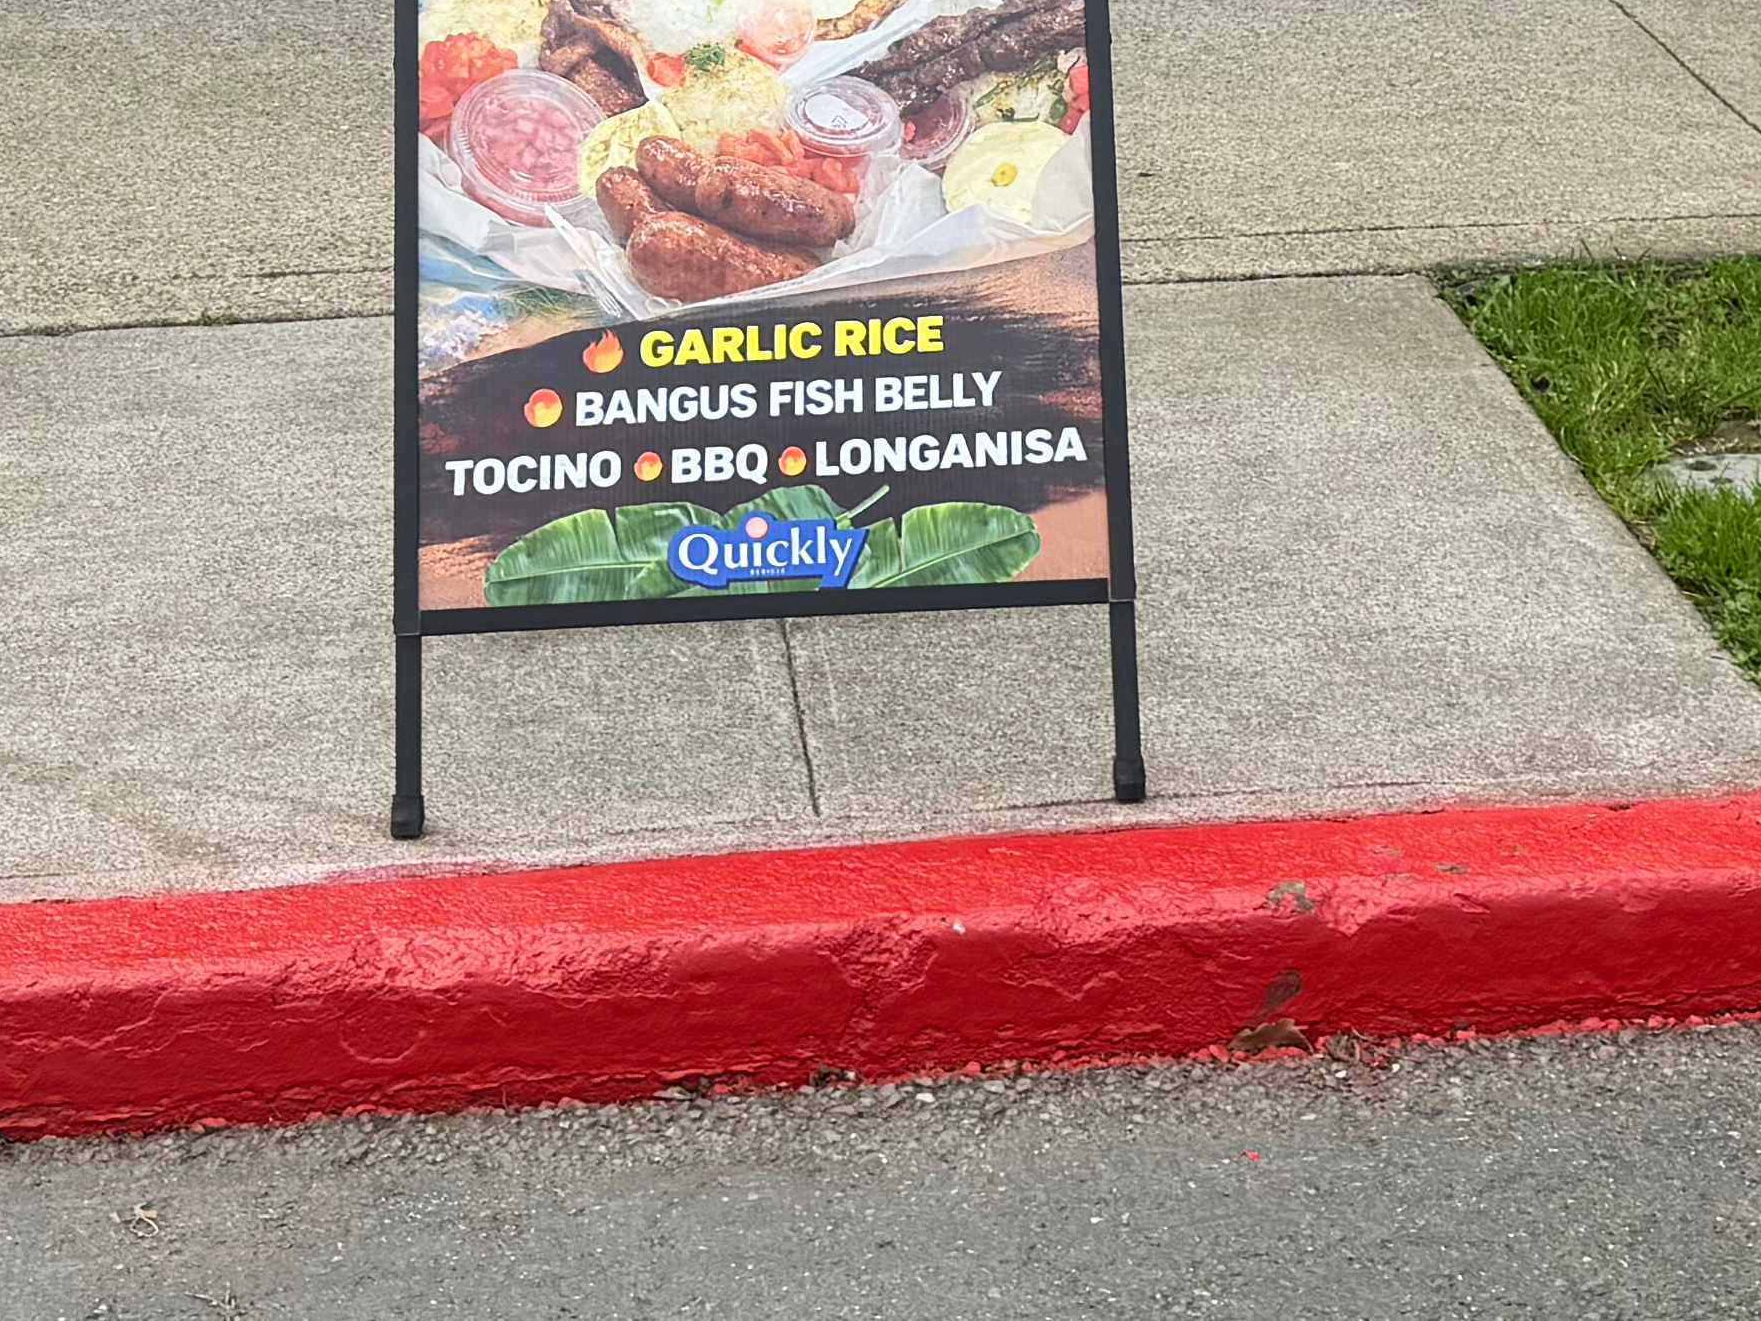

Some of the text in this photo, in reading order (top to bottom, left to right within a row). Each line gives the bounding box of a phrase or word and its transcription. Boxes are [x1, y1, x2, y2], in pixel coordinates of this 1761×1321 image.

[640, 314, 945, 369] GARLIC RICE
[574, 370, 1003, 427] BANGUS FISH BELLY
[444, 426, 1088, 497] TOCINO BBQ LONGANISA
[677, 517, 855, 577] Quickly
